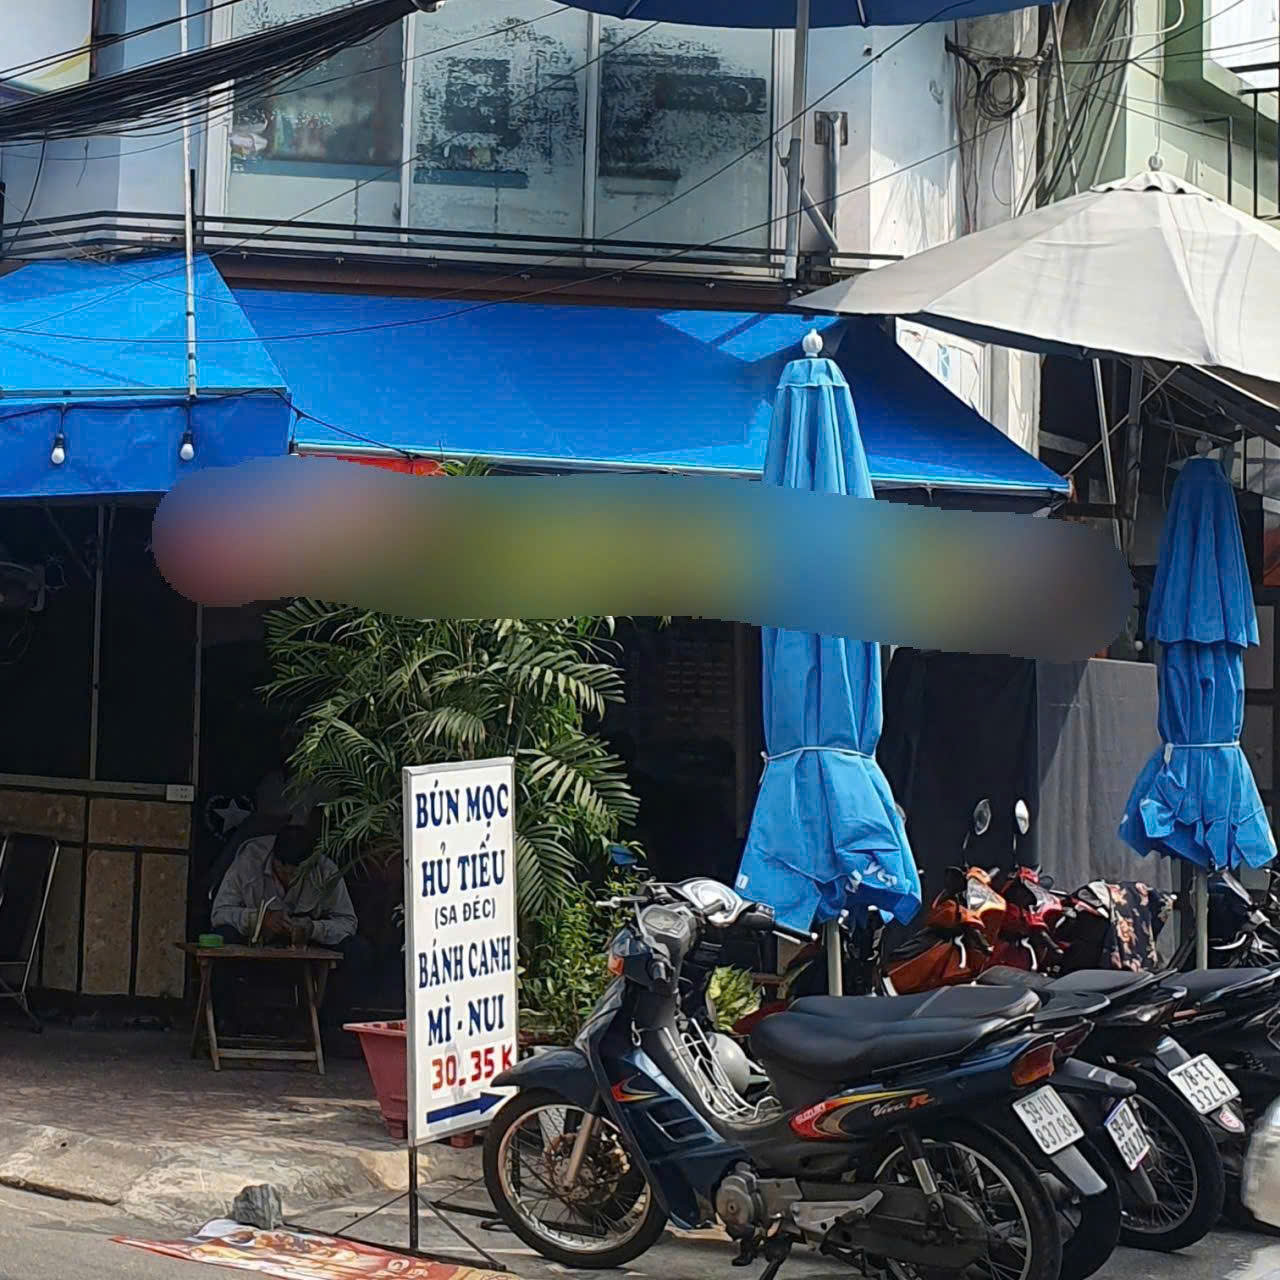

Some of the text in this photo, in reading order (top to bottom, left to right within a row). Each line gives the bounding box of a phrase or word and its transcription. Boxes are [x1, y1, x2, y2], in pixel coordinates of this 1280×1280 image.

[416, 779, 509, 829] BÚN MỌC
[422, 833, 506, 897] HỦ TIẾU
[434, 904, 458, 929] (SA
[418, 935, 511, 989] BÁNH CANH
[428, 994, 451, 1046] MÌ
[468, 994, 505, 1036] NUI
[794, 1102, 826, 1125] SUZUKI
